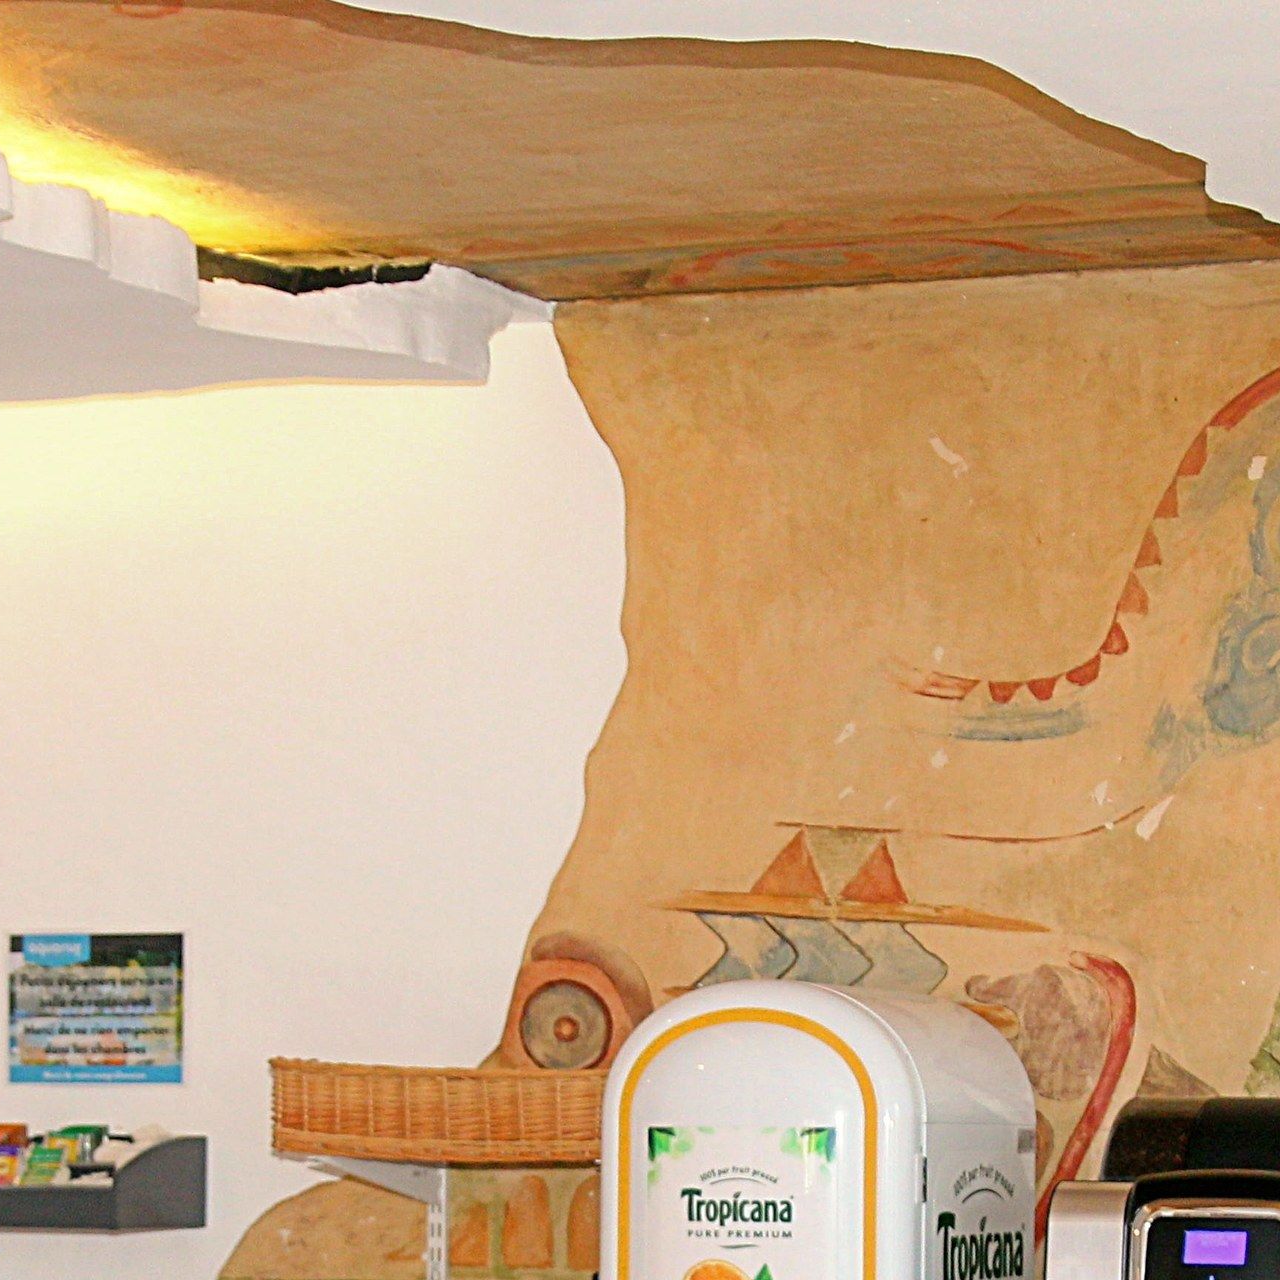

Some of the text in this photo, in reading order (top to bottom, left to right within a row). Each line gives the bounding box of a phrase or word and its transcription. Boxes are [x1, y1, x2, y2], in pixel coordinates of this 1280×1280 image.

[681, 1188, 793, 1227] Tropicana
[687, 1229, 793, 1238] PURE PREMIUM
